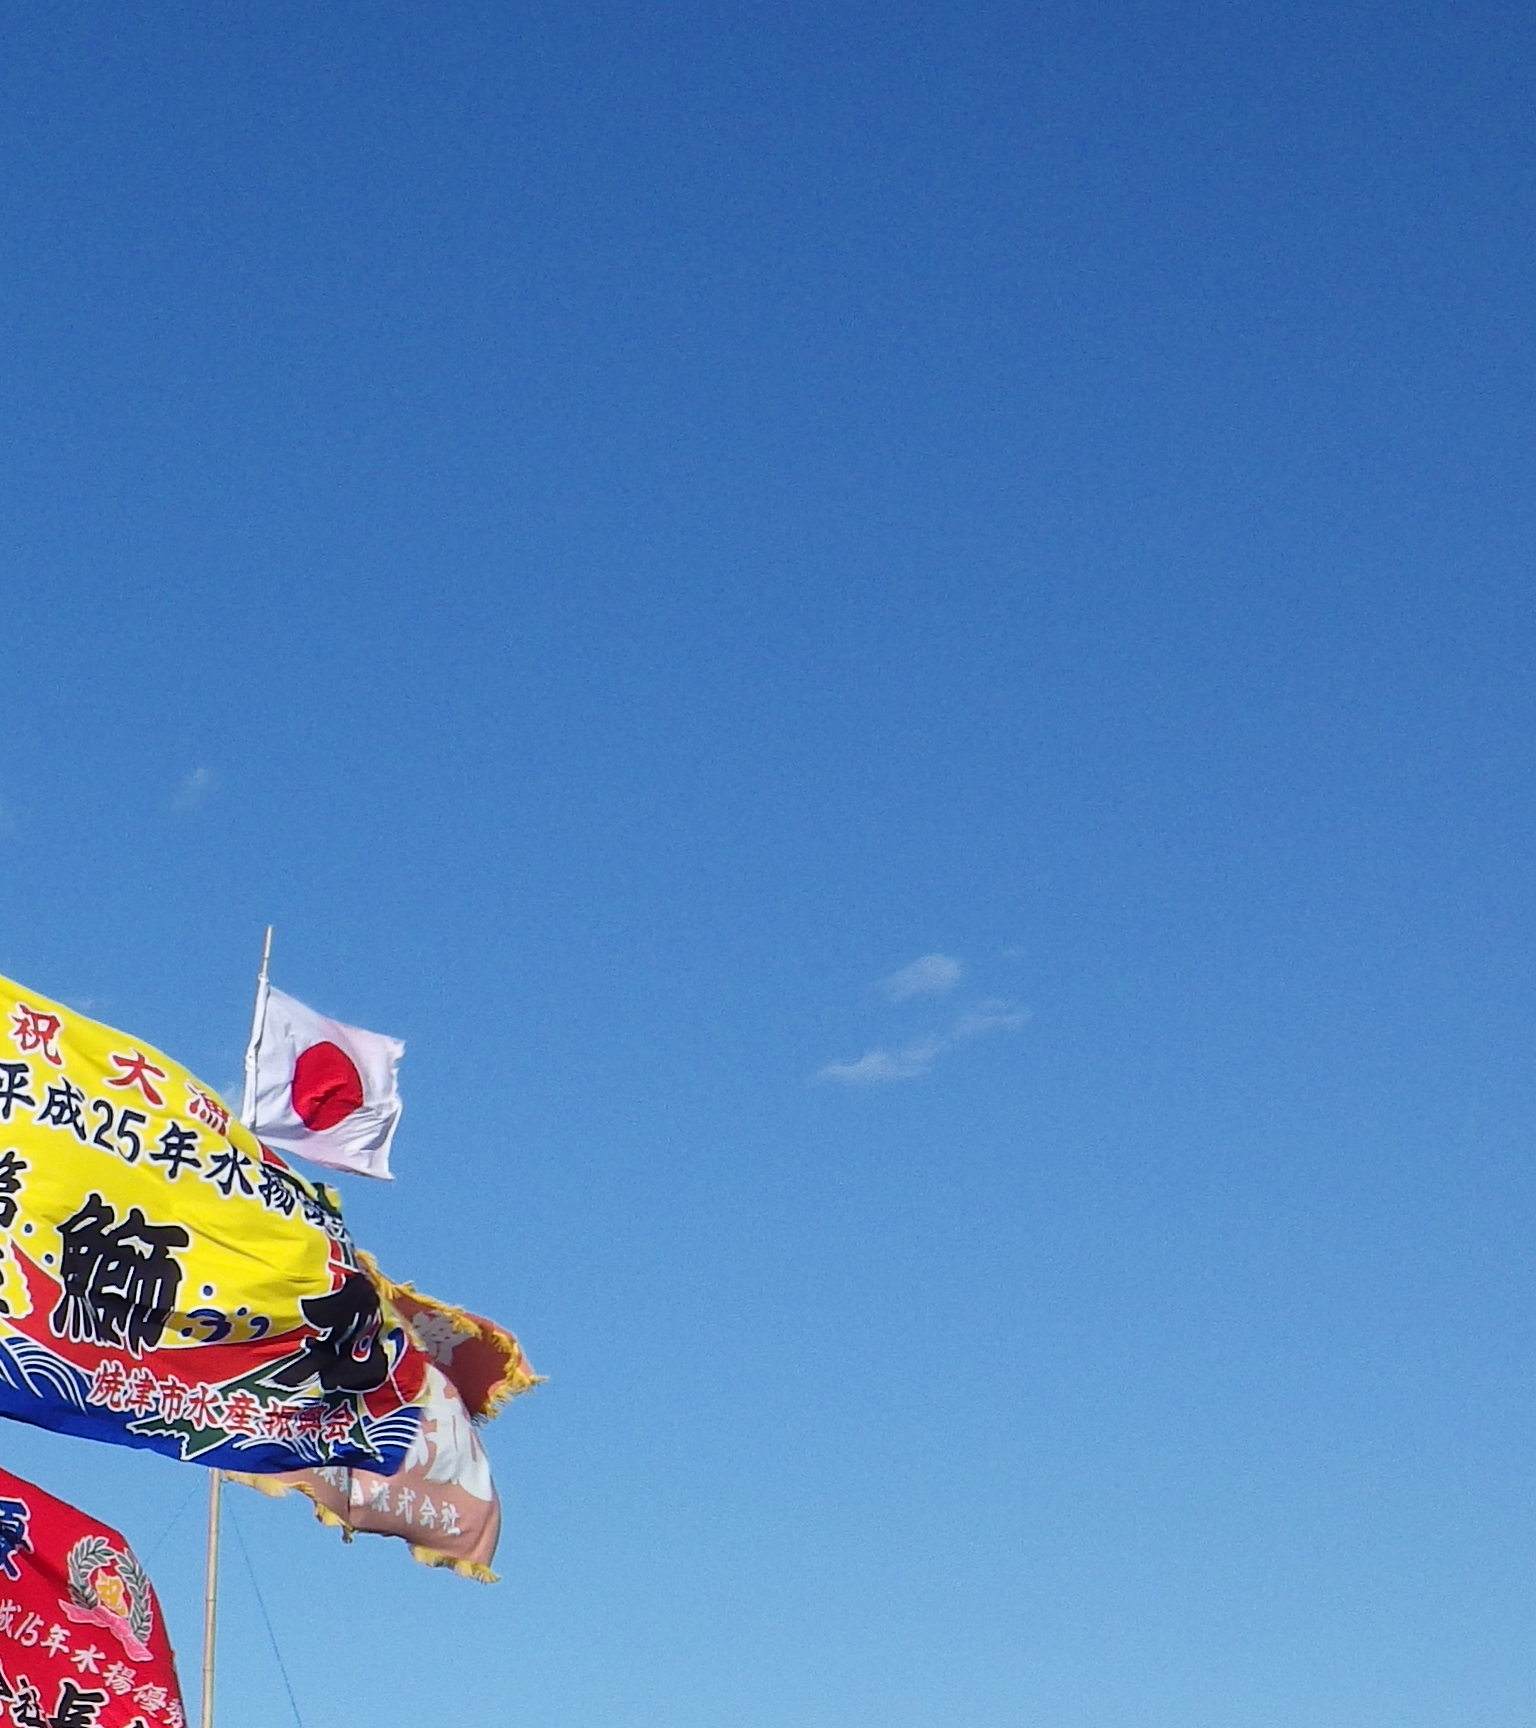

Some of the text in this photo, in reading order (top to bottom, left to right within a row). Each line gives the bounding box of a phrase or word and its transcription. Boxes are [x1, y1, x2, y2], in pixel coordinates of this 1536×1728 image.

[11, 1002, 65, 1067] 祝
[110, 1046, 168, 1106] 大
[86, 1360, 359, 1443] 焼津市水産振興会
